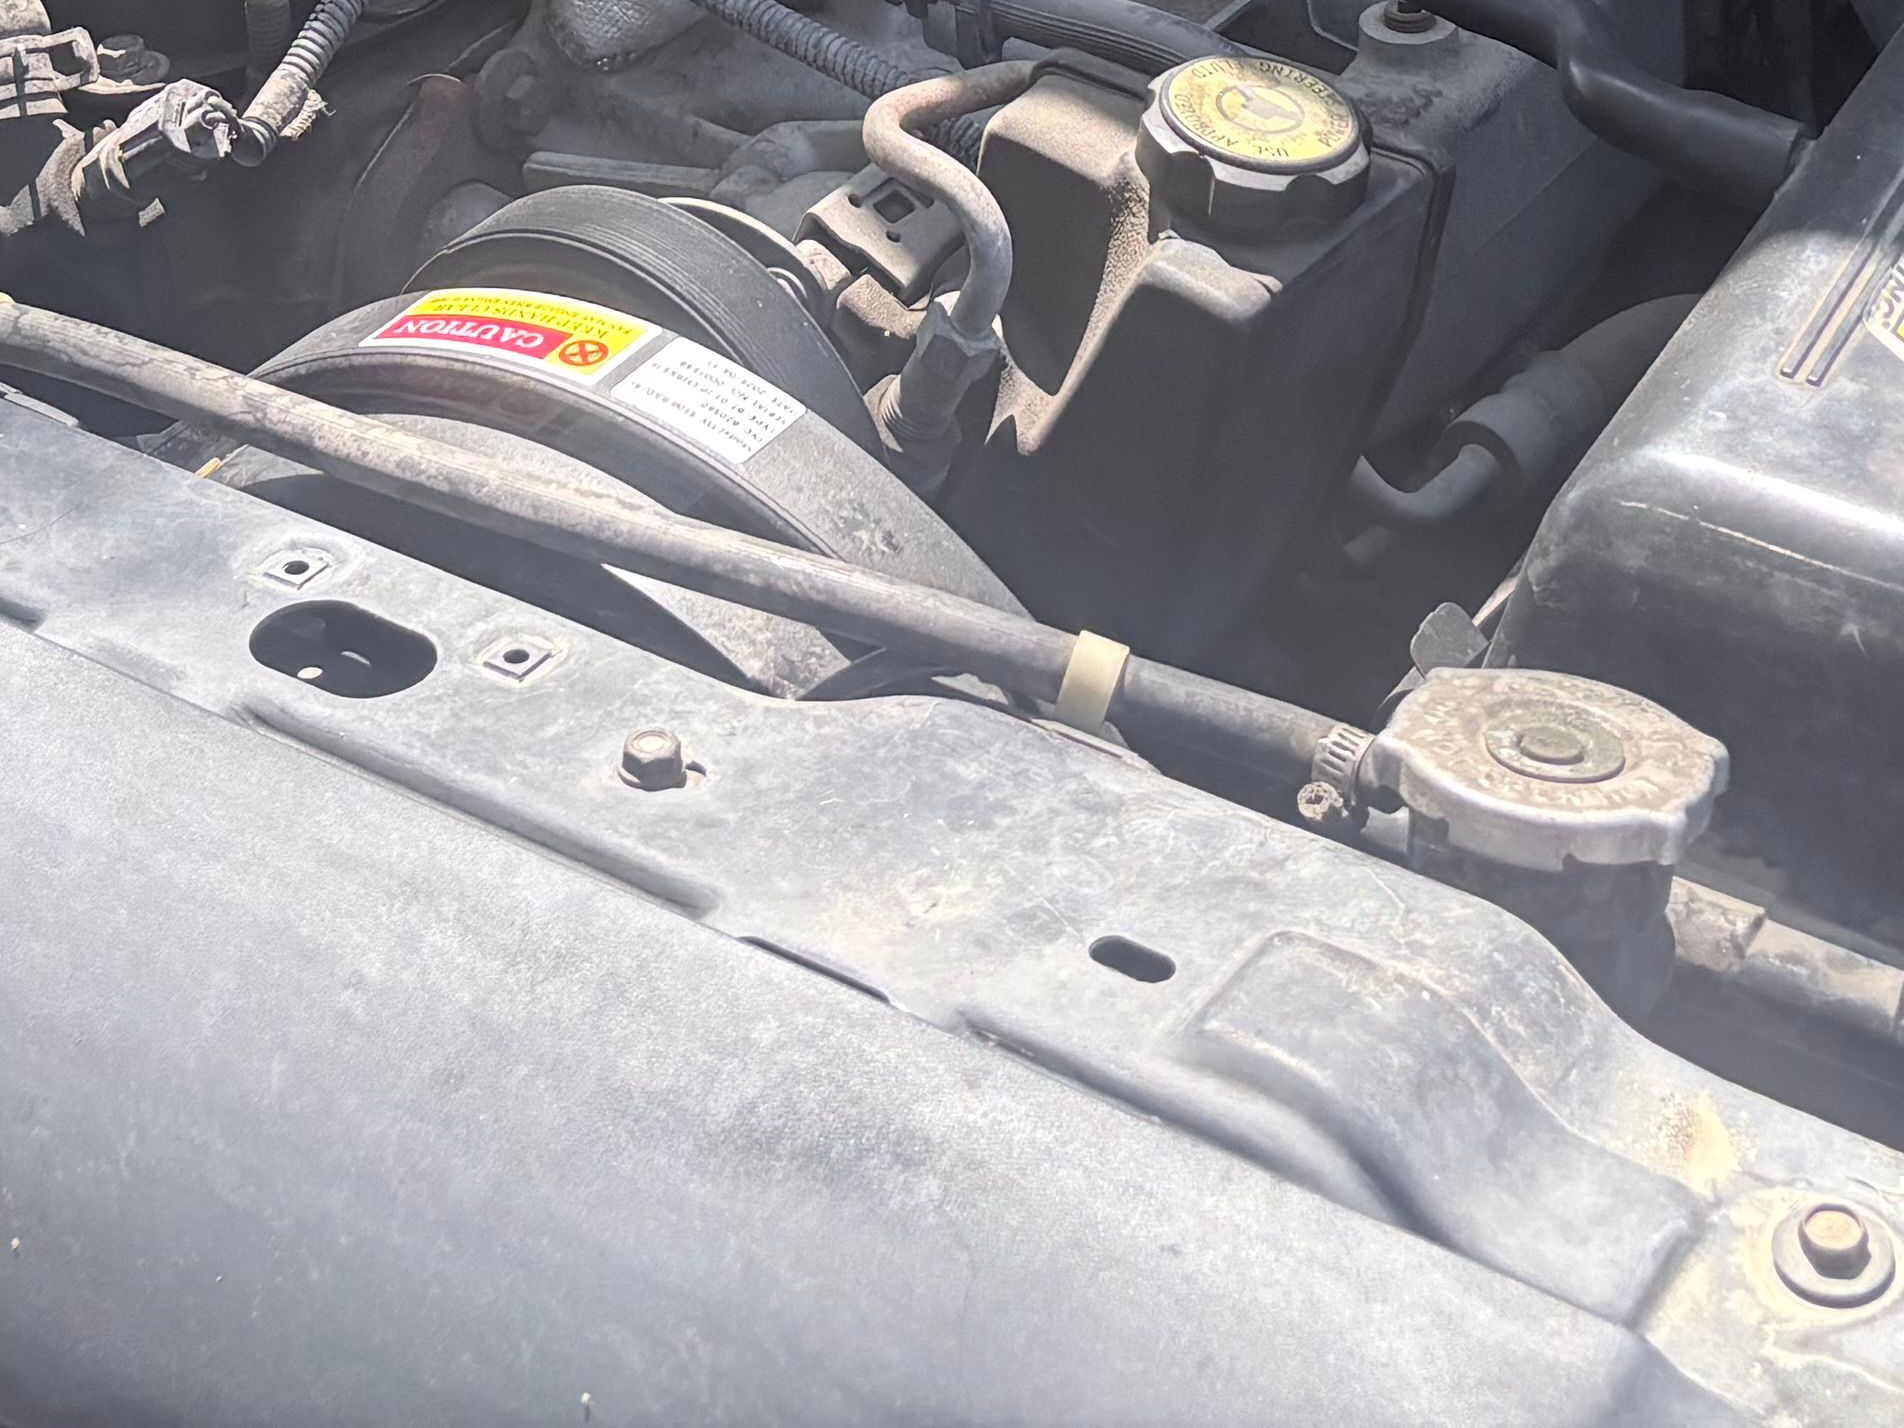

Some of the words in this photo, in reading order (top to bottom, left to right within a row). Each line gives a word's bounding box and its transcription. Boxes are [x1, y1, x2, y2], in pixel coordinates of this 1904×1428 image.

[434, 304, 493, 313] CLEAR
[494, 307, 556, 324] HANDS
[395, 319, 544, 349] CAUTION
[557, 320, 609, 340] KEEP
